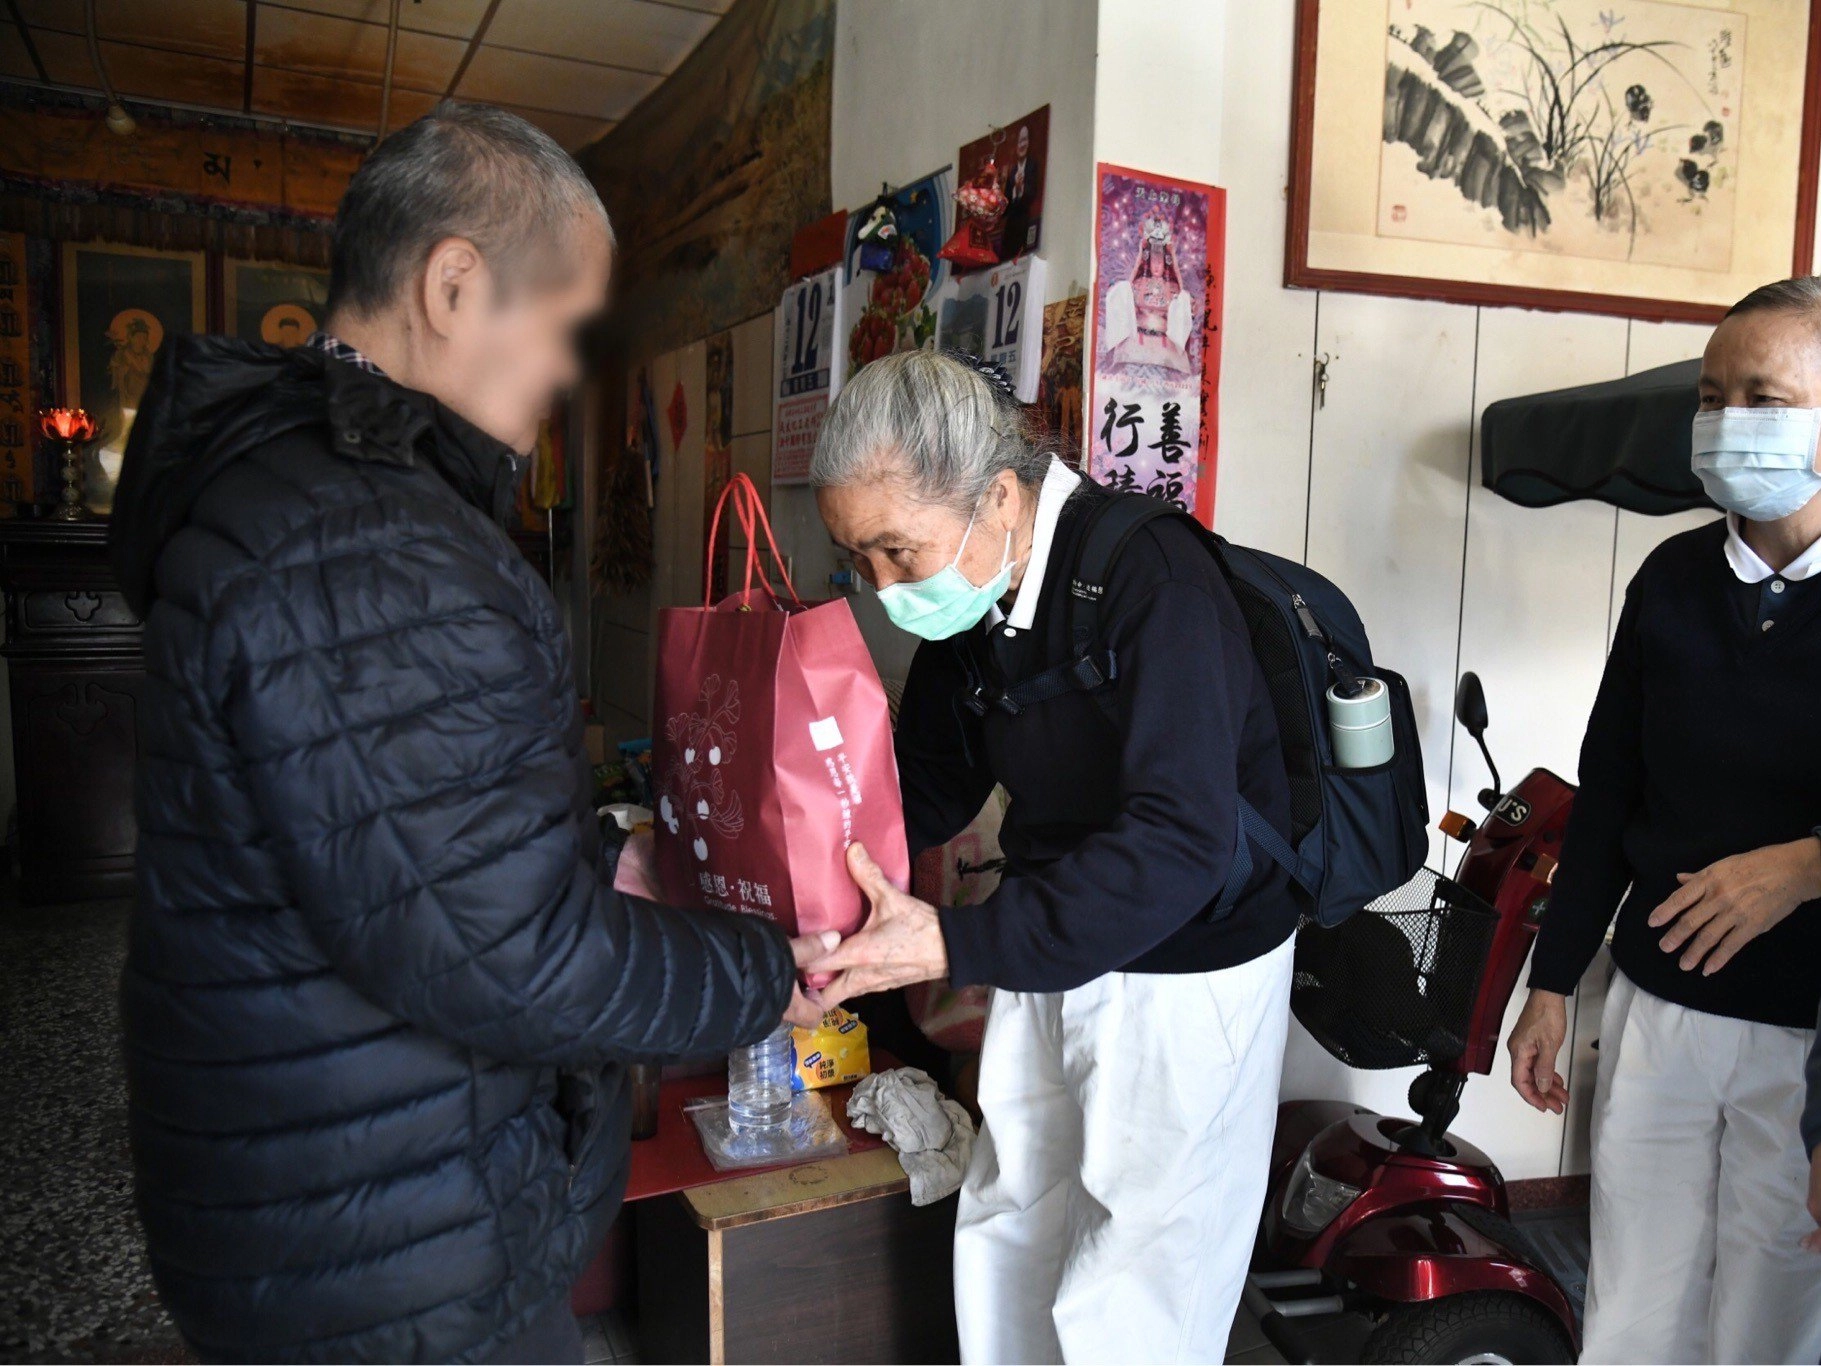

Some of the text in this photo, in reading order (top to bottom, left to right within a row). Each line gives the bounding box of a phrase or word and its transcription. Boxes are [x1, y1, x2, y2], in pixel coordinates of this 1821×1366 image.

[791, 282, 822, 375] 12
[992, 281, 1021, 349] 12
[1100, 397, 1191, 464] 行善
